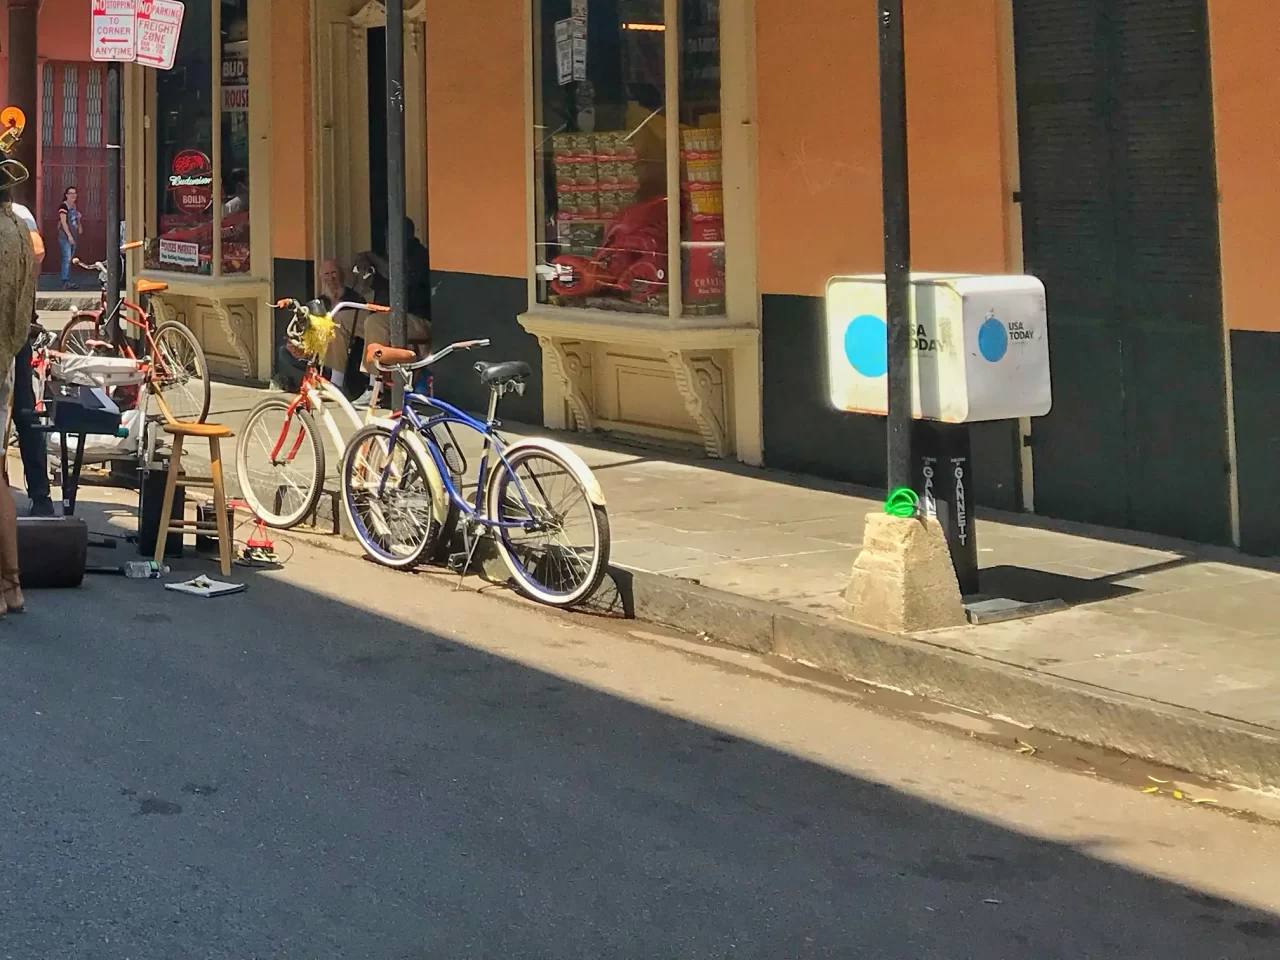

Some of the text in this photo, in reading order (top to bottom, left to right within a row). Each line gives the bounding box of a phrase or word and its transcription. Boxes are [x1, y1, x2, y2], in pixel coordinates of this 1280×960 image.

[106, 0, 135, 10] STOPPING
[138, 0, 181, 19] NO PARKING
[109, 17, 120, 25] TO
[96, 27, 131, 35] CORNER
[138, 20, 175, 35] FREIGHT
[142, 30, 166, 43] ZONE
[95, 47, 132, 57] ANYTIME
[223, 61, 244, 77] BUD
[169, 175, 213, 186] Budweiser
[1008, 321, 1024, 331] USA
[1009, 330, 1034, 340] TODAY
[954, 467, 967, 546] GANNETT
